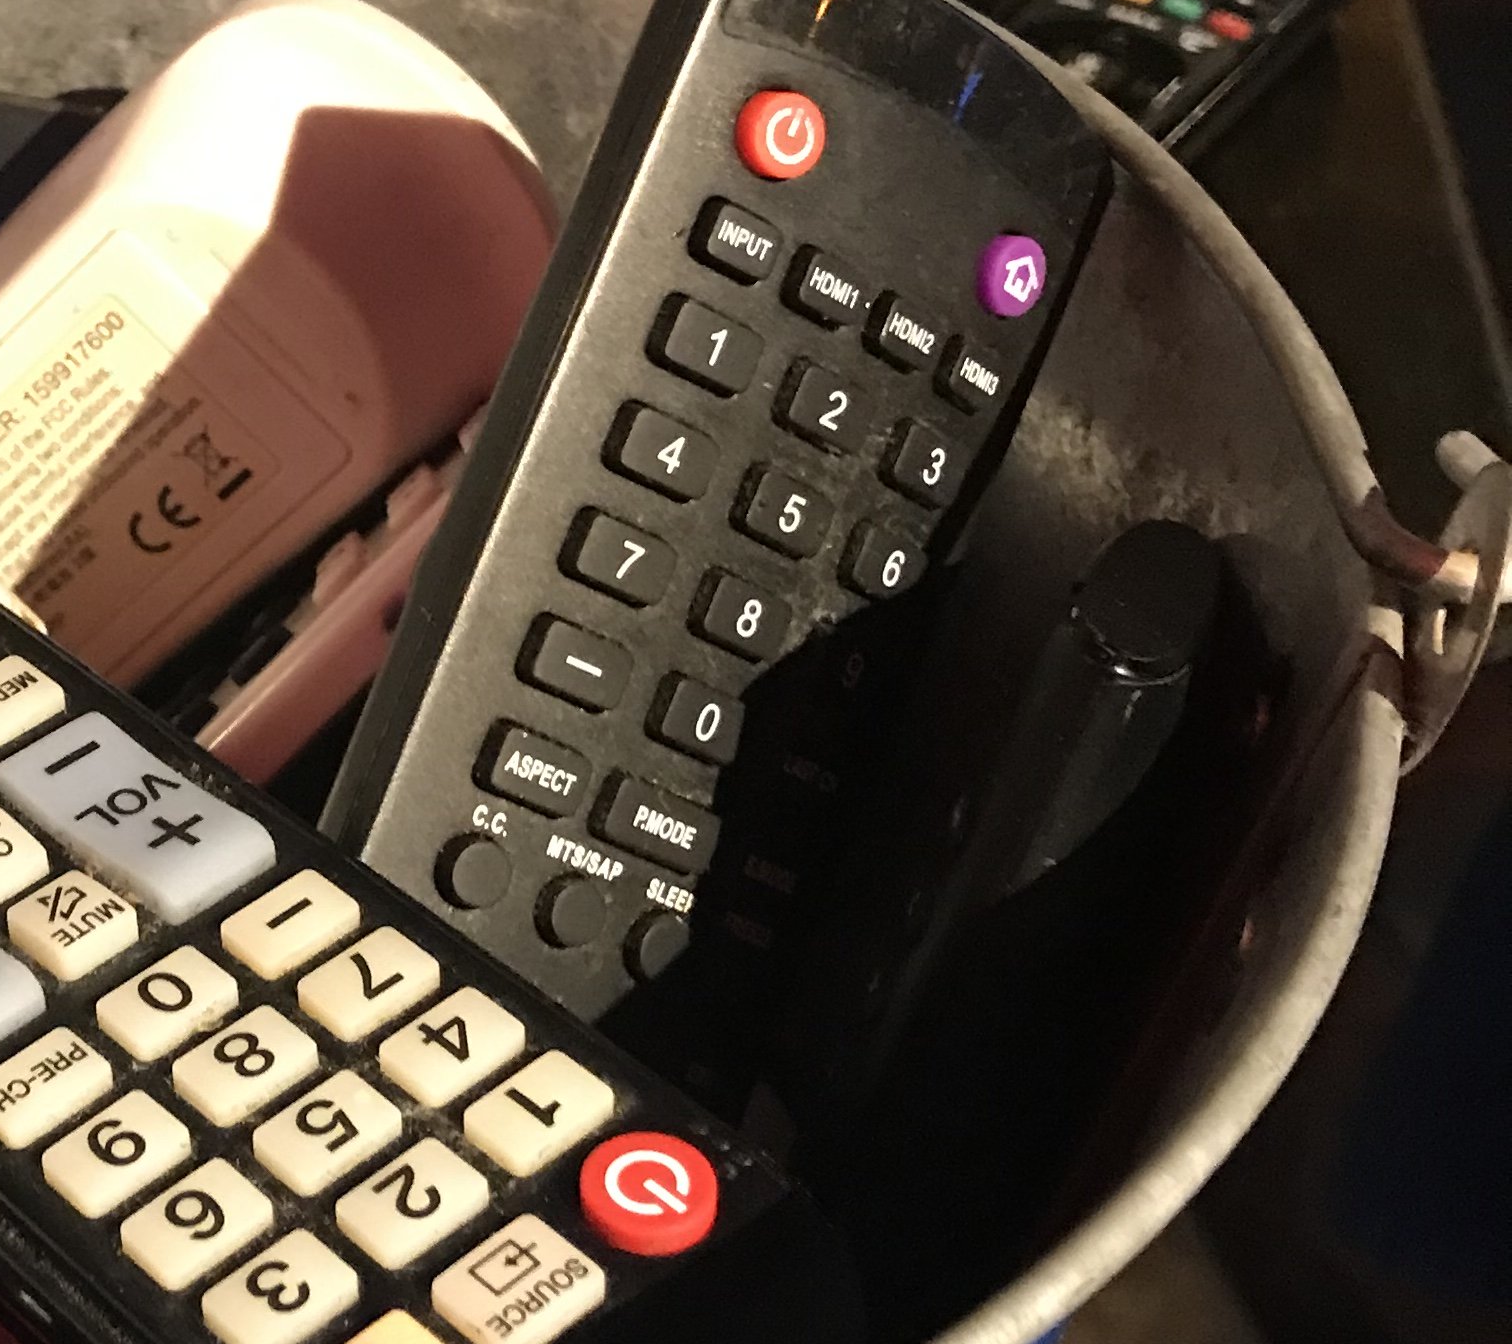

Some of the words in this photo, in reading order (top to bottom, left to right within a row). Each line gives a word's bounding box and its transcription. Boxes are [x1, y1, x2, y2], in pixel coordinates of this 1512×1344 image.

[717, 219, 774, 262] INPUT
[809, 265, 861, 311] HDMI1
[707, 328, 729, 368] 1
[887, 311, 936, 355] HDMI2
[23, 310, 126, 408] 159917600
[959, 356, 1000, 397] HDMI3
[818, 390, 849, 432] 2
[656, 435, 687, 476] 4
[922, 447, 947, 487] 3
[129, 484, 202, 554] CE
[778, 493, 808, 534] 5
[615, 539, 647, 579] 7
[881, 549, 906, 589] 6
[735, 598, 764, 639] 8
[694, 702, 722, 743] 0
[504, 749, 578, 798] ASPECT
[74, 772, 183, 827] VOL
[471, 803, 509, 838] C.C.
[632, 804, 698, 851] P.MODE
[545, 834, 624, 883] MTS/SAP
[50, 898, 126, 948] MUTE
[136, 971, 194, 1013] 0
[349, 952, 405, 1001] 7
[212, 1031, 276, 1079] 8
[416, 1015, 471, 1064] 4
[294, 1099, 360, 1154] 5
[503, 1087, 563, 1129] 1
[86, 1118, 147, 1167] 9
[163, 1189, 226, 1241] 6
[371, 1164, 442, 1220] 2
[244, 1260, 310, 1314] 3
[486, 1256, 591, 1341] SOURCE
